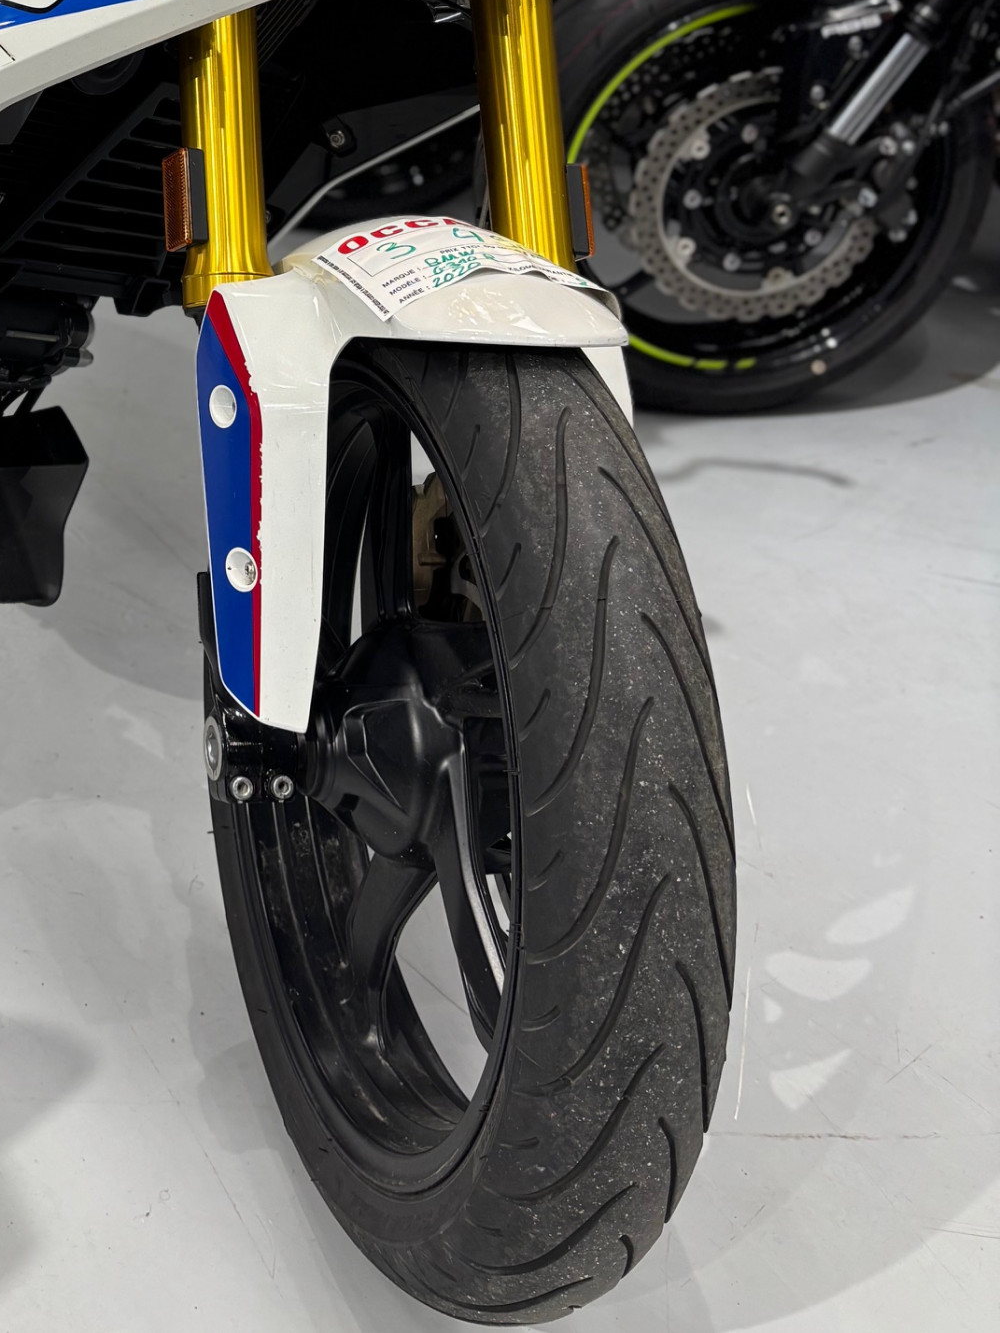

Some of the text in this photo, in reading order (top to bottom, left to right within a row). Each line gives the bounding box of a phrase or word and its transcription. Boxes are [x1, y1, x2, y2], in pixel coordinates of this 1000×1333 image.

[381, 269, 416, 289] MARQUE
[424, 249, 475, 268] BMW
[399, 287, 425, 304] ANNÉE
[432, 261, 482, 288] 2020
